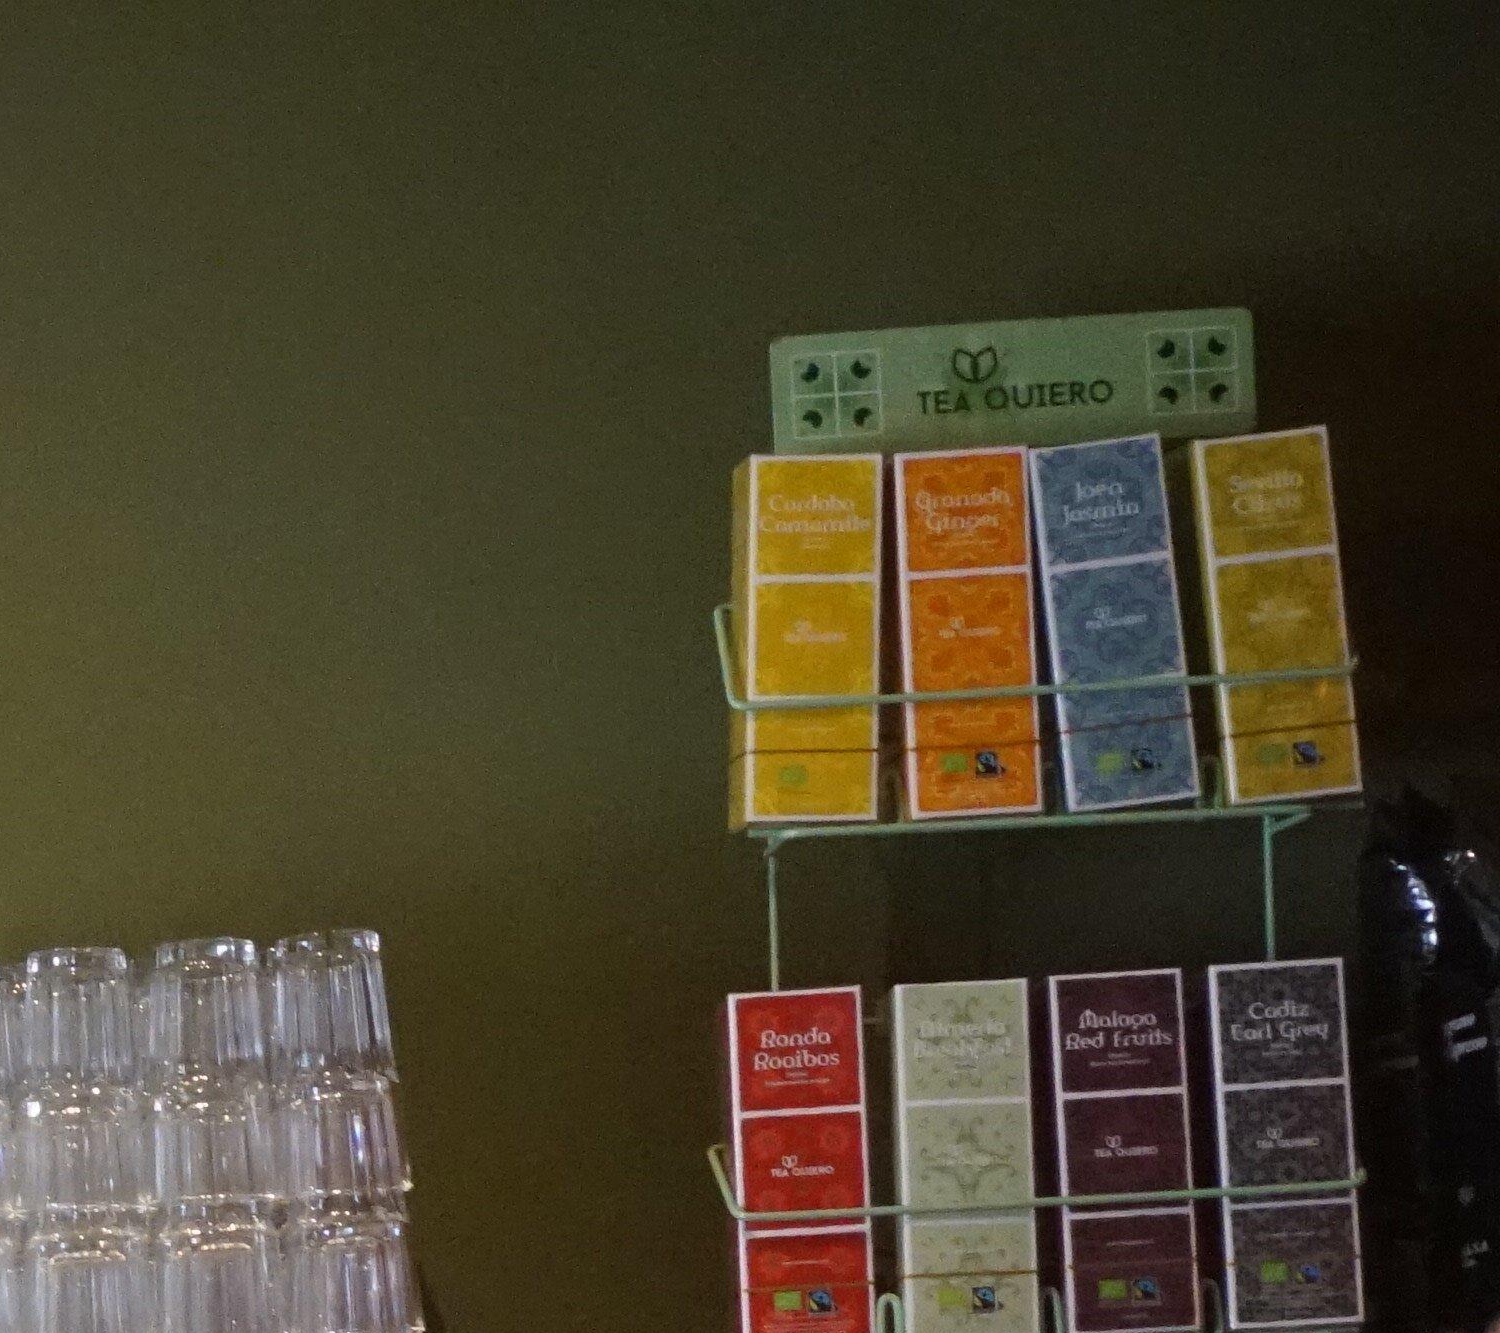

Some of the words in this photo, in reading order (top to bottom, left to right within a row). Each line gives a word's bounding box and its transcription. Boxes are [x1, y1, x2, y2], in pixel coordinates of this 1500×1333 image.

[916, 388, 971, 415] TEA
[984, 379, 1114, 410] QUIERO
[760, 1027, 832, 1049] Ronda
[1065, 1032, 1105, 1051] Red
[753, 1050, 841, 1071] Rooibos
